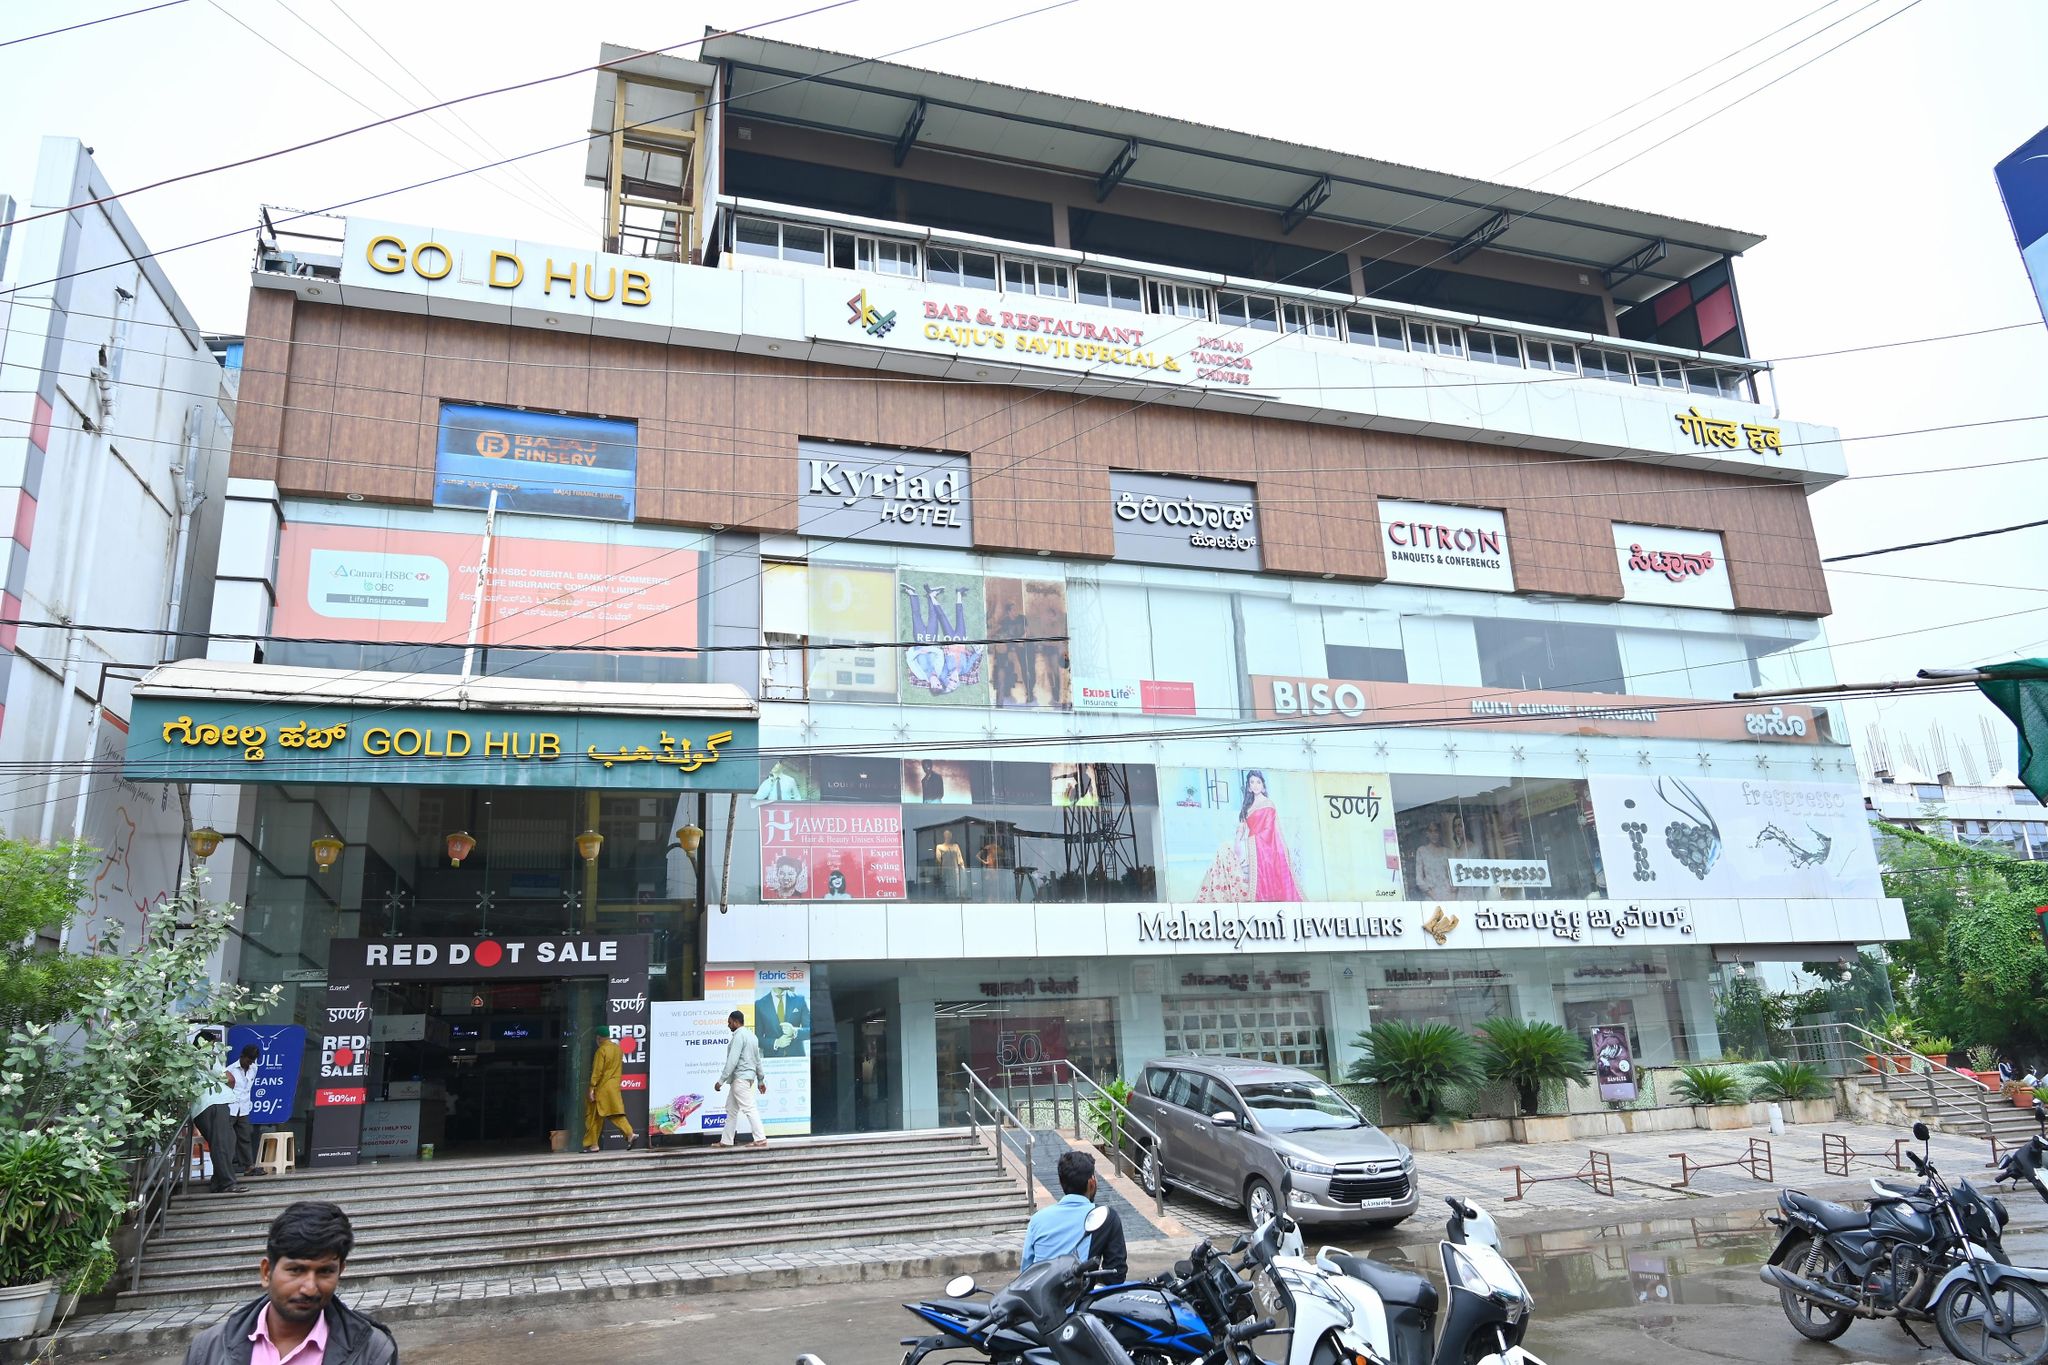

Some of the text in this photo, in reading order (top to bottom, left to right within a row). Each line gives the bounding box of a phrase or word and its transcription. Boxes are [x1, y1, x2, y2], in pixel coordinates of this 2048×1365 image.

[544, 258, 653, 307] HUB
[923, 301, 1145, 346] BAR & RESTAURANT
[924, 323, 1181, 372] GAJJU'S SAVJI SPECIAL &
[1197, 336, 1244, 354] INDIAN
[1191, 351, 1252, 371] TANDOOR
[1196, 367, 1251, 386] CHINESE
[1675, 406, 1782, 456] गोल्ड हब
[514, 448, 597, 467] FINSERV
[809, 460, 961, 507] Kyriad
[881, 501, 963, 528] HOTEL
[1116, 492, 1254, 530] ಕಿರಿಯಾಡ್
[1190, 530, 1257, 551] ಹೋಟೆಲ್
[1388, 520, 1500, 555] CITRON
[1391, 551, 1500, 570] BANQUETS & CONFERENCES
[349, 568, 413, 581] Canara HSBC
[459, 565, 499, 575] CANRA
[502, 568, 527, 577] HSBC
[530, 570, 574, 580] ORIENTAL
[577, 573, 605, 582] BANK
[619, 575, 671, 586] COMMERCE
[375, 584, 394, 592] OBC
[487, 579, 646, 595] LIFE INSURANCE COMPANY LIMITED
[349, 596, 406, 606] Life Insurance
[1111, 688, 1130, 699] Life
[1272, 681, 1365, 717] BISO
[1472, 700, 1512, 715] MULTI
[1517, 703, 1571, 717] CUISINE
[278, 720, 348, 749] ಹಬ್
[362, 726, 561, 760] GOLD HUB
[1323, 786, 1382, 822] soch
[1742, 781, 1846, 812] frespresso
[795, 817, 847, 835] JAWED
[851, 817, 899, 834] HABIB
[801, 835, 816, 843] Hair
[826, 835, 849, 844] Beauty
[851, 836, 874, 844] Unisex
[876, 836, 899, 844] Saloon
[870, 849, 899, 858] Expert
[871, 863, 900, 872] Styling
[1455, 863, 1547, 883] frespresso
[876, 876, 898, 884] With
[876, 889, 897, 897] Care
[1138, 909, 1404, 949] Mahalaxmi JEWELLERS
[367, 944, 438, 967] RED
[537, 941, 618, 963] SALE
[326, 1001, 368, 1024] soch
[610, 992, 647, 1014] soch
[609, 1024, 647, 1039] RED
[323, 1035, 366, 1051] RED
[321, 1064, 364, 1078] SALE
[254, 1077, 284, 1086] EANS
[255, 1088, 266, 1097] @
